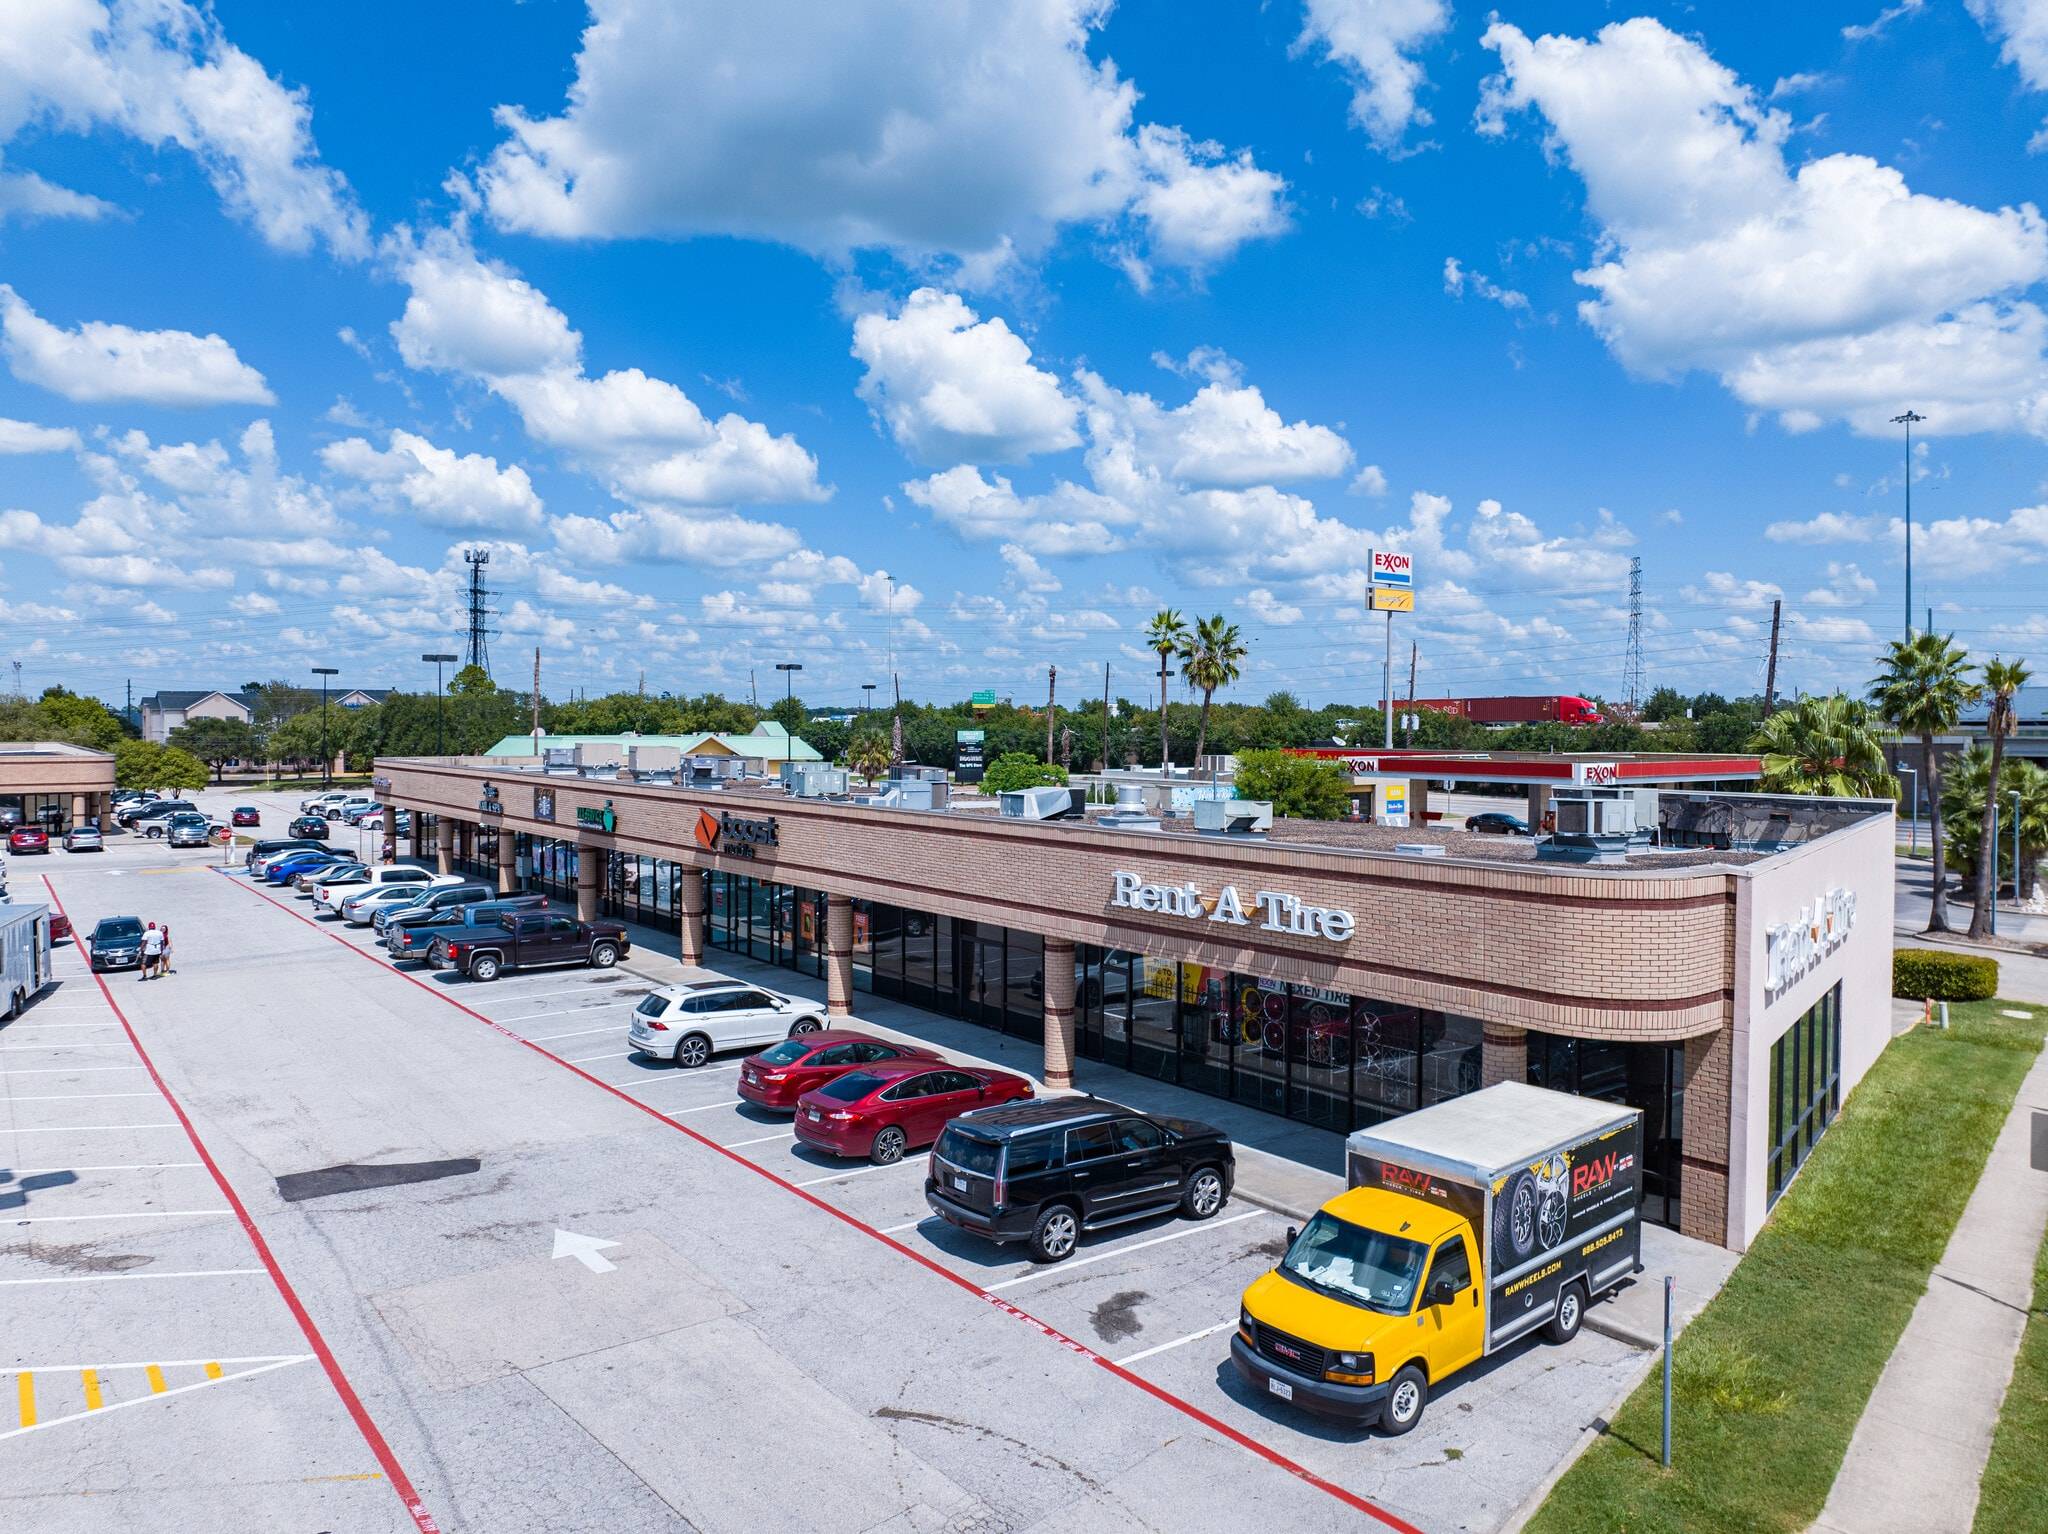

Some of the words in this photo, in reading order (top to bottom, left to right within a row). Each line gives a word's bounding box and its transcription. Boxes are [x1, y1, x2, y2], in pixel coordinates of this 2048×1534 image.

[1375, 553, 1409, 572] EXXON
[1586, 764, 1616, 784] EXXON
[722, 811, 778, 846] boost
[1111, 871, 1204, 919] Rent
[1208, 885, 1250, 925] A
[1256, 890, 1355, 942] Tire
[1765, 906, 1813, 991] Rent
[1322, 988, 1351, 1004] TIRE
[1381, 1163, 1431, 1191] RAW
[1574, 1151, 1617, 1195] RAW
[1504, 1260, 1562, 1296] RAWWHEELS.COM
[1274, 1342, 1301, 1360] GMC
